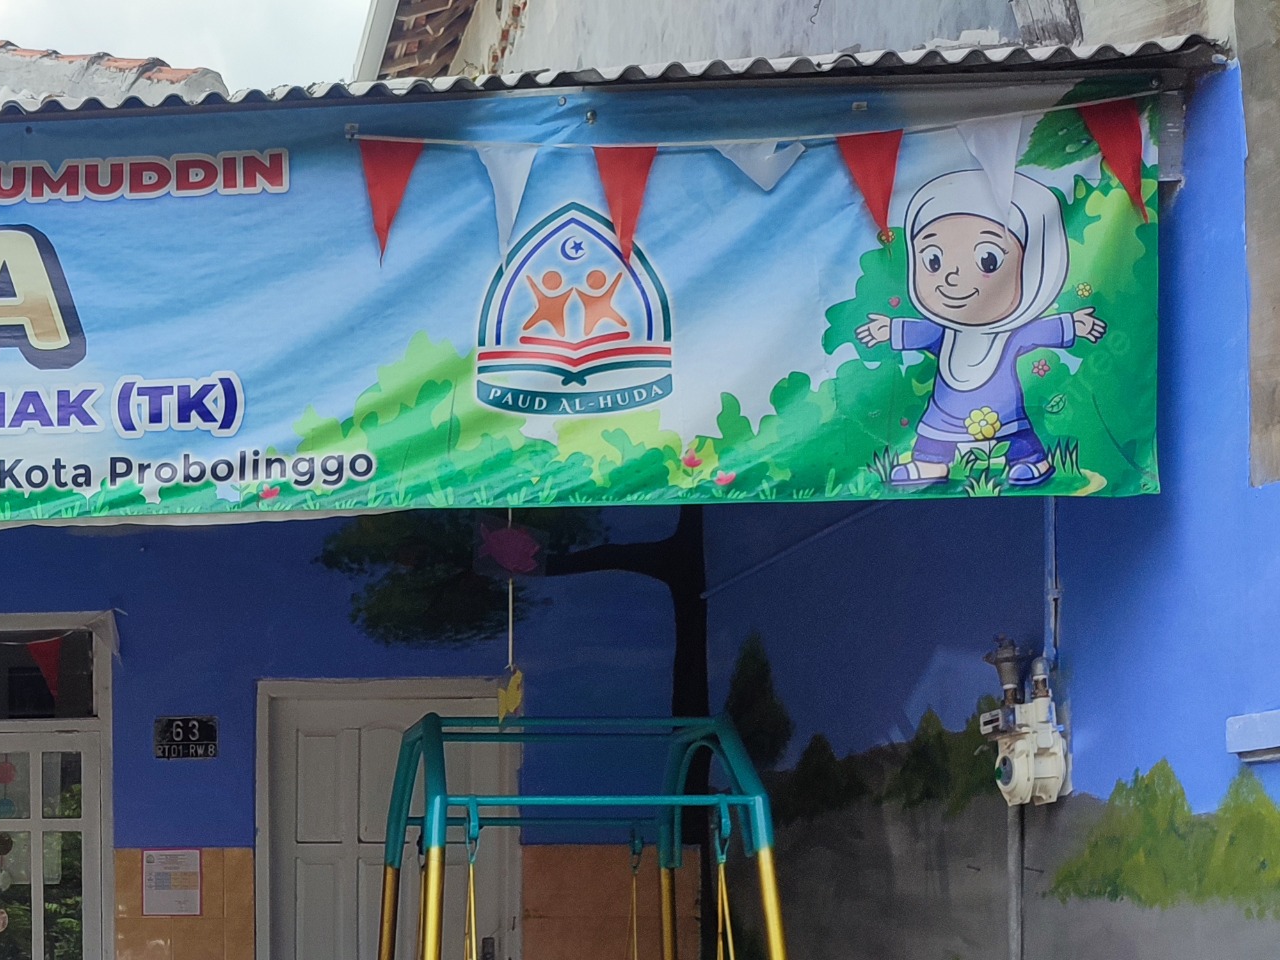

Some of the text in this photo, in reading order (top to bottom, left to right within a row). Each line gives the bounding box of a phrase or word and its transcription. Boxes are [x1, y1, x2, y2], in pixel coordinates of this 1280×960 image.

[117, 376, 238, 432] (TK)
[488, 384, 664, 414] PAUD AL-HUDA
[109, 449, 373, 487] Probolinggo
[172, 720, 200, 741] 63
